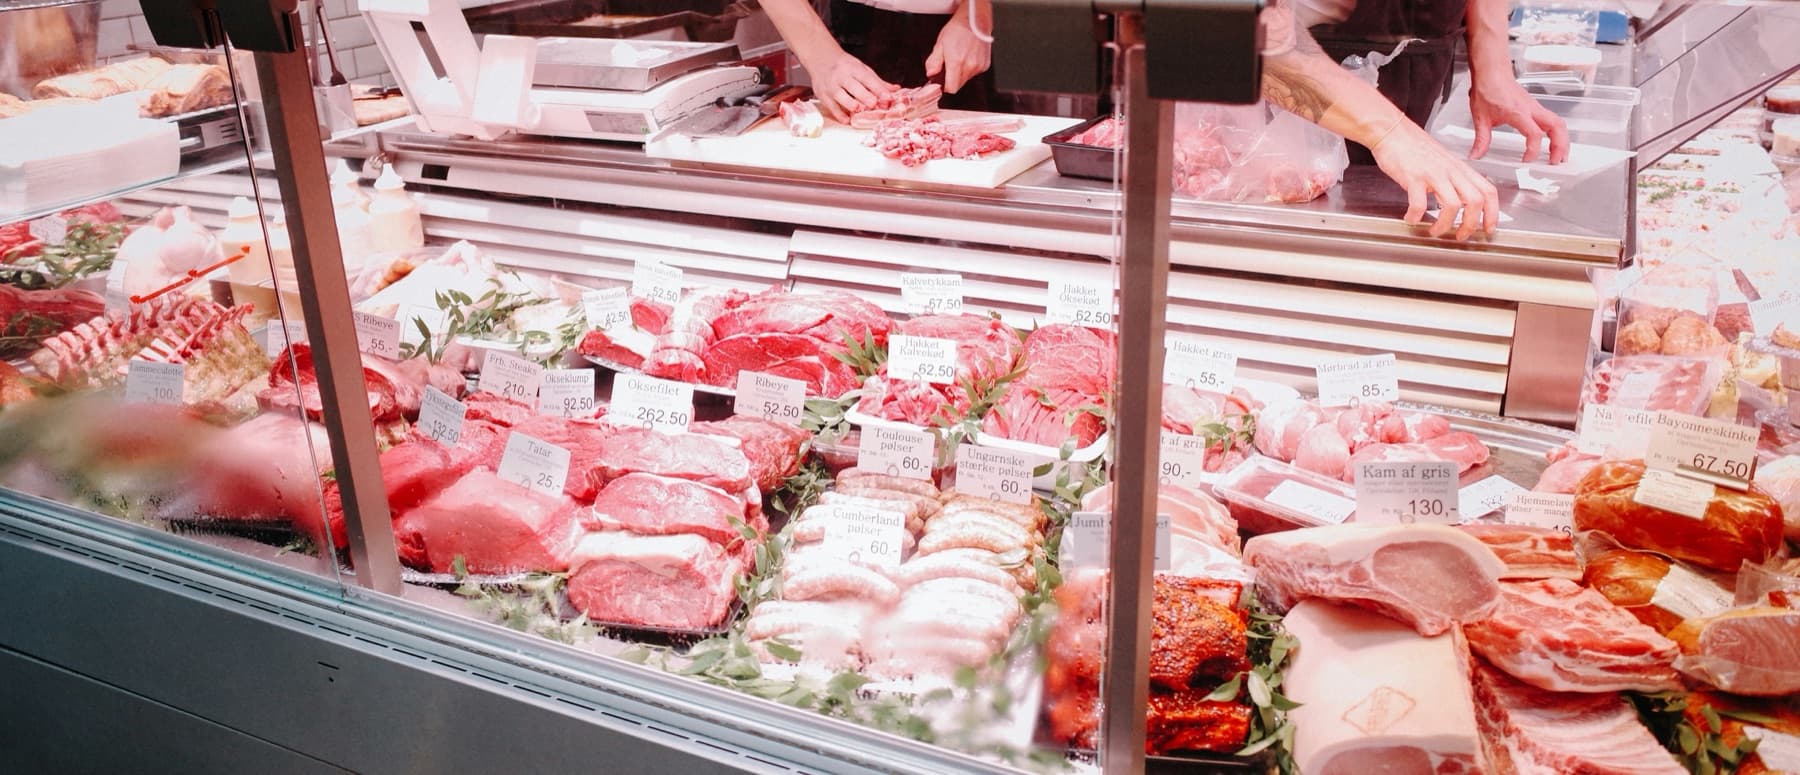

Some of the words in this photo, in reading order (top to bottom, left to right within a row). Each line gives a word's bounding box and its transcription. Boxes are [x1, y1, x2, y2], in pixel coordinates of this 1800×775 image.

[902, 276, 961, 289] Kalvetykkam
[1063, 283, 1097, 296] Hakket
[928, 298, 961, 311] 67,50
[1059, 294, 1100, 306] Oksekød
[362, 313, 395, 331] Ribeye
[1075, 310, 1111, 325] 62,50
[370, 338, 393, 353] 55,-
[905, 337, 940, 350] Hakket
[1173, 341, 1209, 356] Hakket
[1212, 349, 1234, 361] gris
[899, 347, 945, 360] Kalvekød
[508, 357, 538, 377] Steaks
[918, 363, 954, 379] 62,50
[1317, 359, 1360, 373] Mørbrad
[1363, 359, 1373, 369] af
[1376, 357, 1396, 371] gris
[545, 373, 590, 386] Okseklump
[627, 378, 680, 397] Oksefilet
[755, 376, 790, 392] Ribeye
[1199, 371, 1225, 389] 55,-
[503, 380, 532, 399] 210,-
[1362, 384, 1391, 398] 85,-
[563, 396, 593, 412] 92,50
[762, 401, 800, 418] 52,50
[636, 406, 688, 427] 262,50
[873, 427, 924, 444] Toulouse
[1657, 413, 1757, 442] Bayonneskinke
[527, 439, 553, 458] Tatar
[880, 440, 915, 454] pølser
[902, 456, 929, 473] 60,-
[967, 447, 1026, 467] Ungarnske
[1692, 453, 1748, 478] 67,50
[959, 460, 996, 474] stærke
[998, 465, 1033, 480] pølser
[1162, 462, 1192, 480] 90,-
[1363, 464, 1397, 479] Kam
[1401, 463, 1417, 479] af
[1421, 464, 1451, 482] gris
[536, 472, 561, 490] 25,-
[1000, 480, 1029, 496] 60,-
[832, 506, 901, 527] Cumberland
[1408, 499, 1458, 518] 130,-
[846, 523, 882, 537] pølser
[870, 541, 899, 556] 60,-
